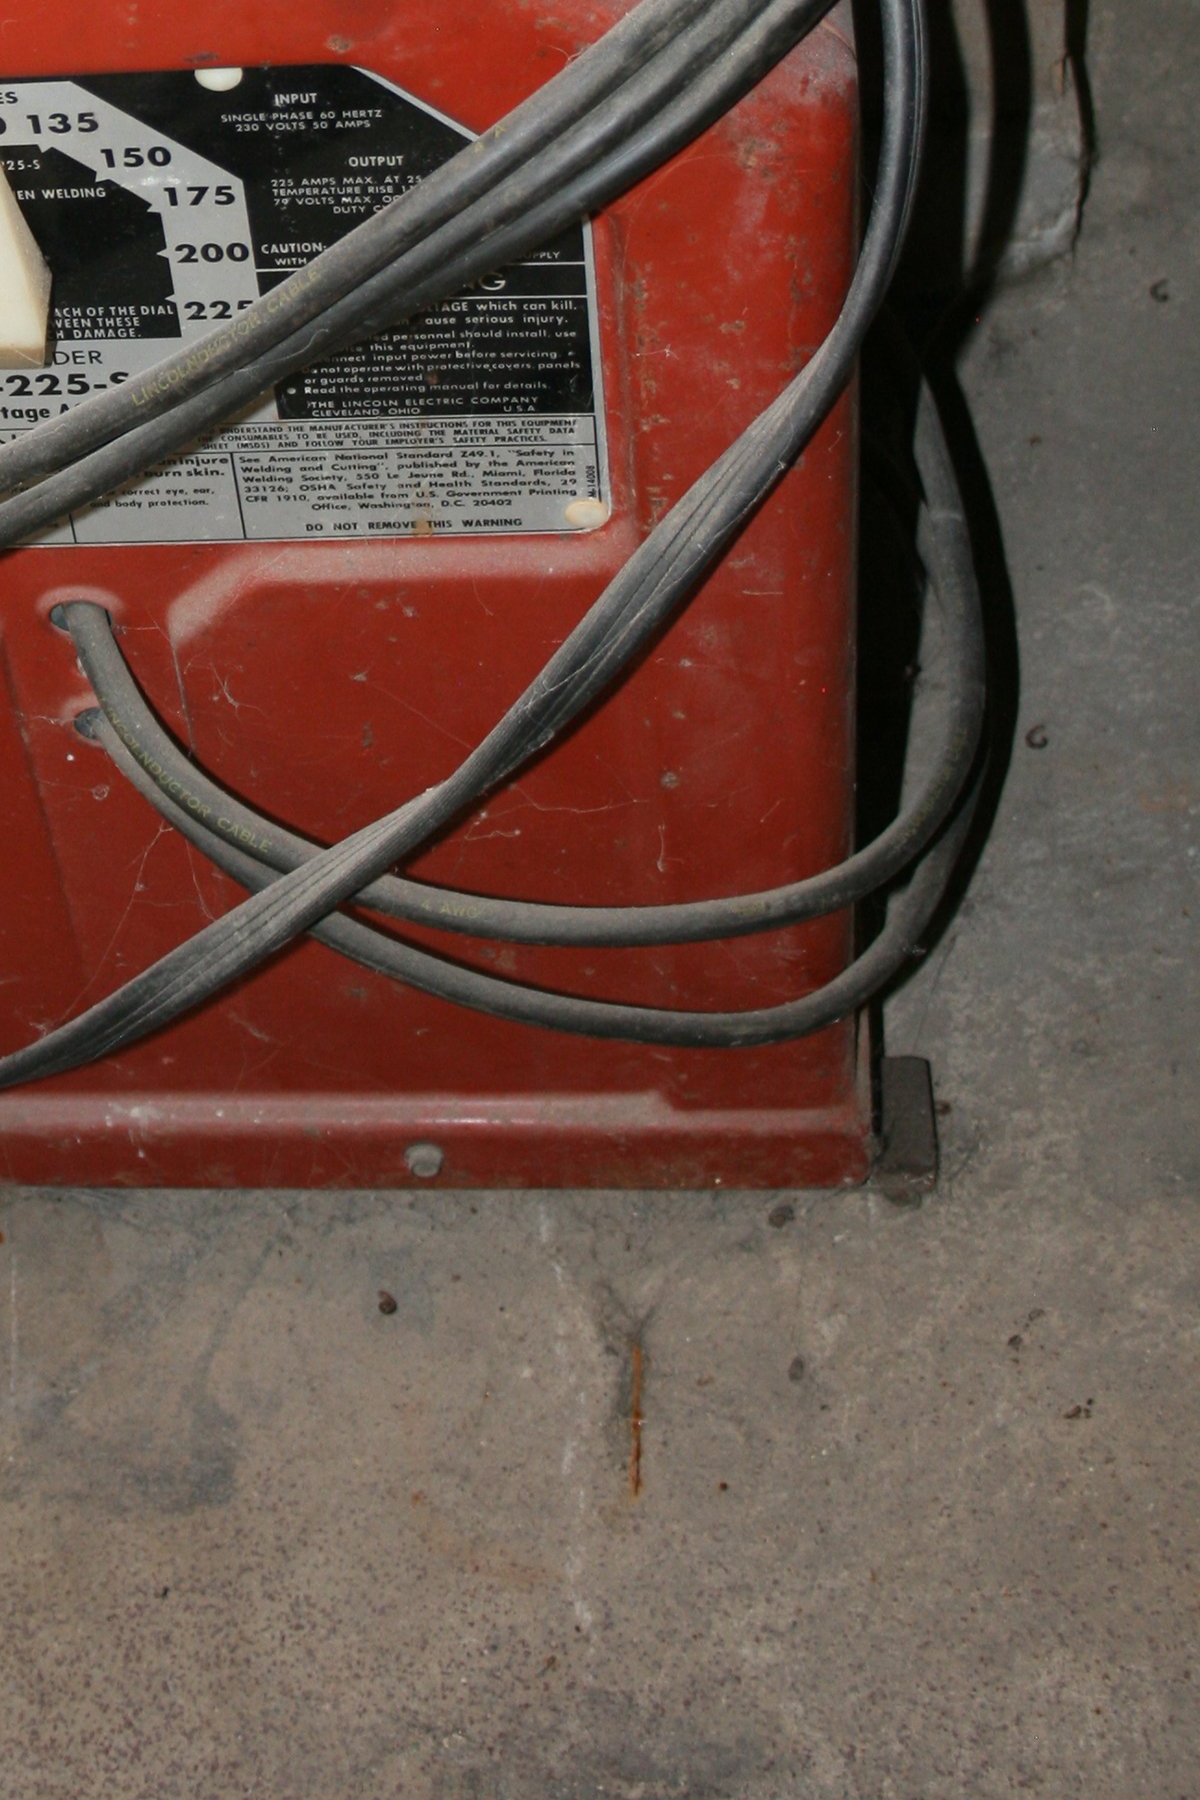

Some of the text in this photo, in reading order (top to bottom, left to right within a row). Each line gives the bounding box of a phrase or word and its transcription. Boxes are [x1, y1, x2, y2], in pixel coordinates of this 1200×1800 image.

[275, 93, 317, 105] INPUT
[221, 109, 382, 123] SINGLE PHASE 60 HERTZ
[26, 112, 99, 135] 135
[235, 119, 371, 132] 230 VOLTS 50 AMPS
[100, 147, 172, 168] 150
[349, 156, 404, 167] OUTPUT
[271, 175, 401, 187] 225 AMPS MAX. AT
[42, 186, 106, 199] WELDING
[163, 186, 236, 206] 175
[272, 185, 393, 196] TEMPERATURE RISE
[296, 195, 377, 205] VOLTS MAX.
[333, 205, 366, 214] DUTY
[174, 242, 250, 264] 200
[275, 257, 307, 266] WITH
[86, 305, 104, 317] OF
[109, 304, 137, 316] THE
[140, 304, 174, 316] DIAL
[476, 302, 517, 312] which
[523, 302, 546, 311] can
[551, 300, 577, 311] kill.
[98, 316, 141, 328] THESE
[465, 314, 568, 326] serious injury.
[73, 326, 142, 339] DAMAGE.
[342, 396, 538, 409] LINCOLN ELECTRIC COMPANY
[388, 407, 421, 416] OHIO
[305, 518, 522, 532] DO NOT REMOVE THIS WARNING
[217, 817, 273, 853] CABLE
